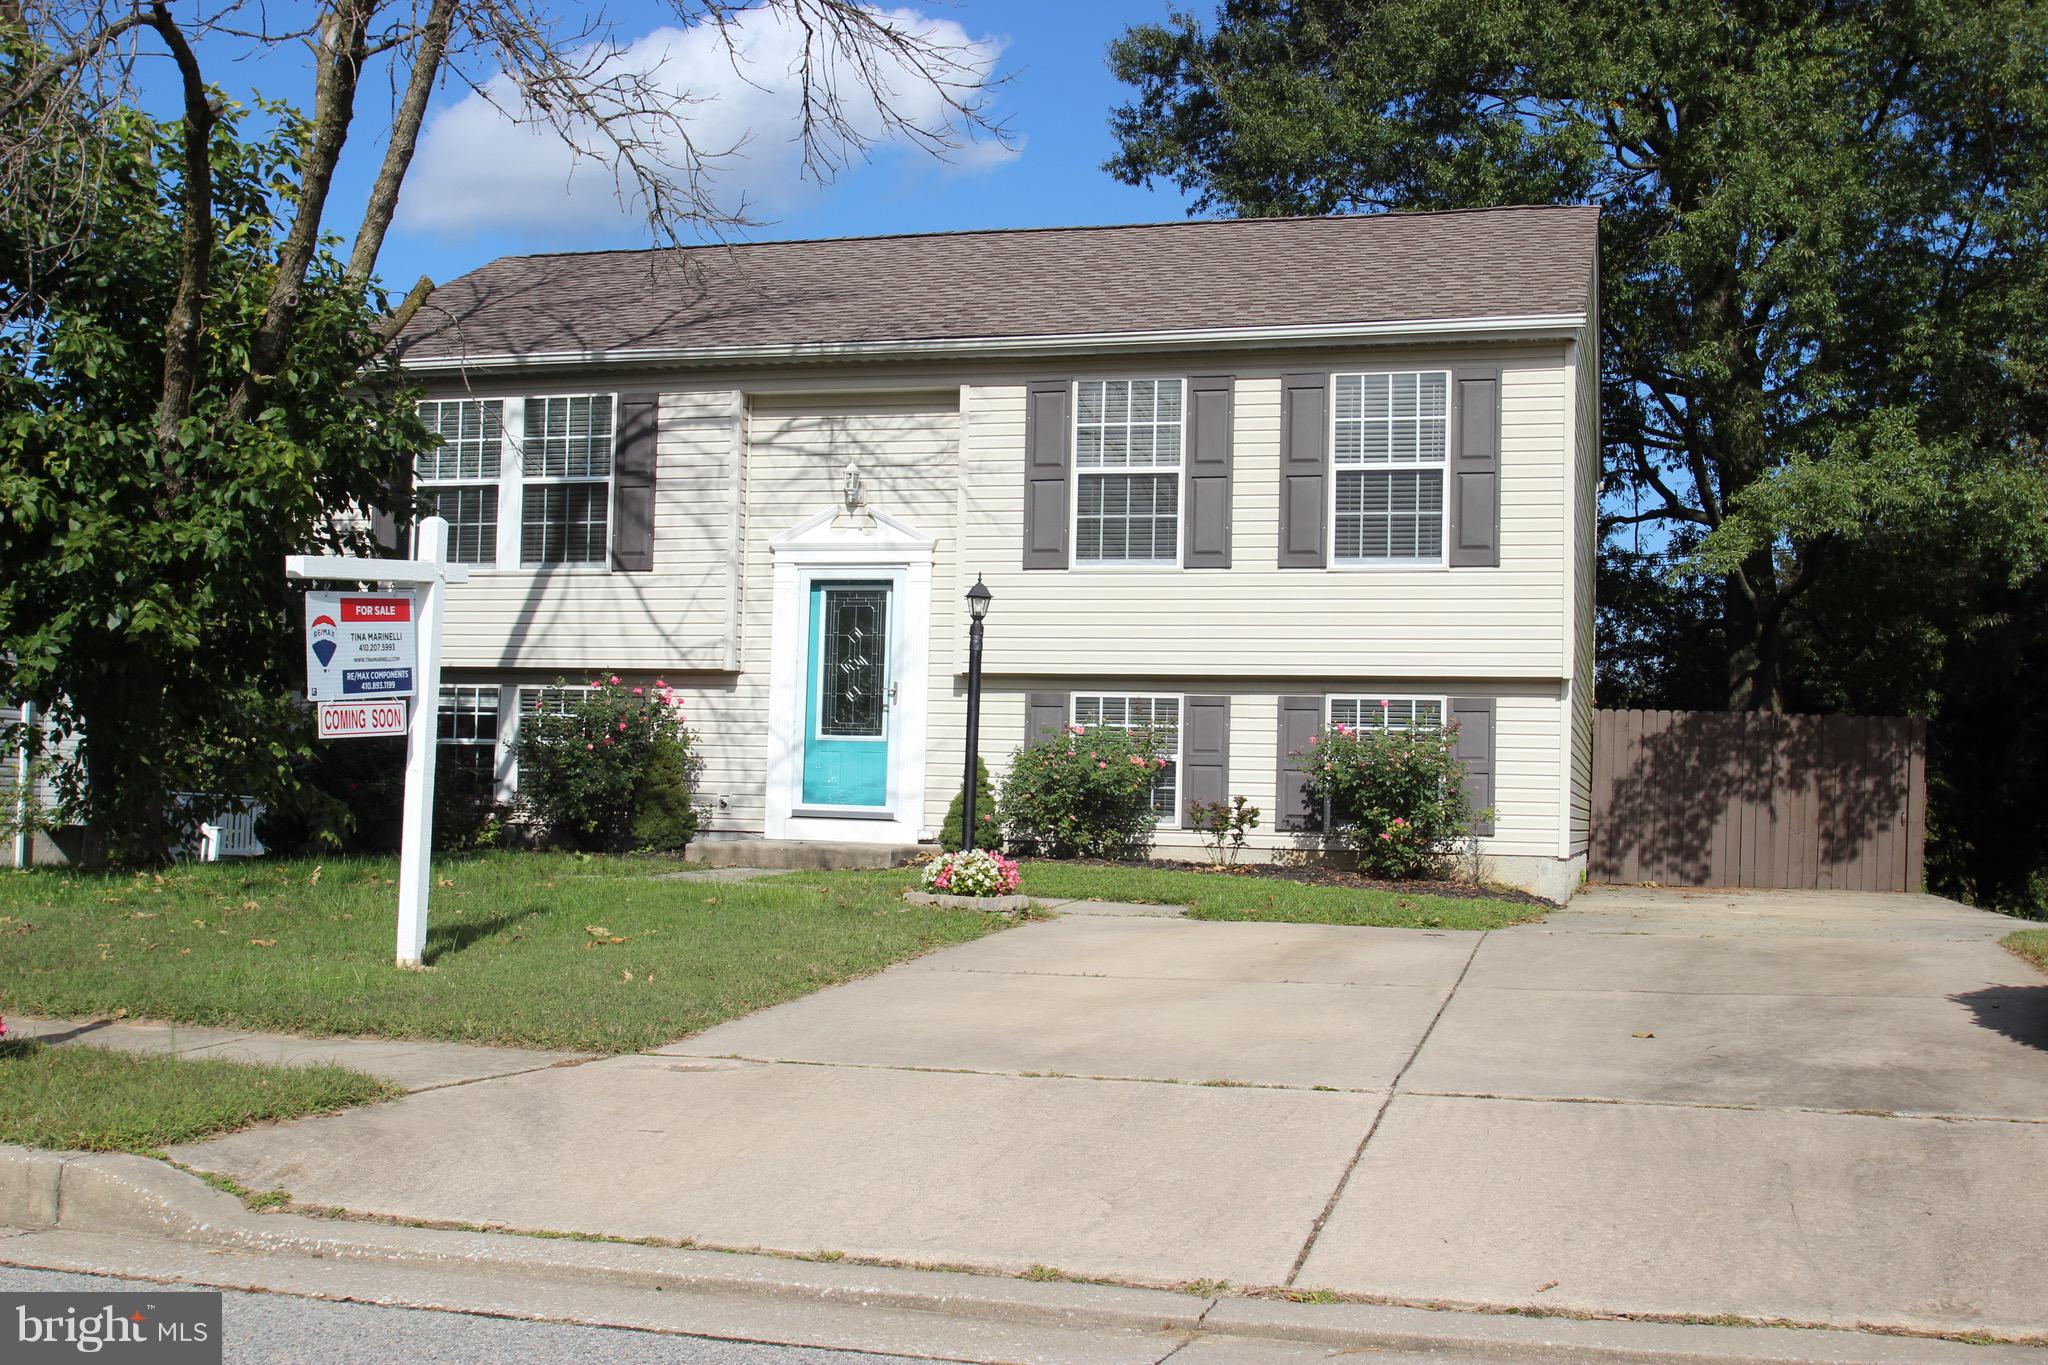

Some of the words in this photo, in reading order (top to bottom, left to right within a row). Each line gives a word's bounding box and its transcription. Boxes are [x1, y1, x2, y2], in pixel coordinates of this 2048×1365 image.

[355, 606, 373, 616] FOR
[374, 606, 395, 615] SALE
[314, 628, 335, 637] RE/MAX
[351, 633, 367, 641] TINA
[367, 633, 403, 641] MARINELLI
[358, 643, 395, 651] 410.207.5993
[346, 672, 370, 681] RE/MAX
[370, 670, 409, 680] COMPONENTS
[324, 709, 366, 730] COMING
[371, 708, 401, 728] SOON
